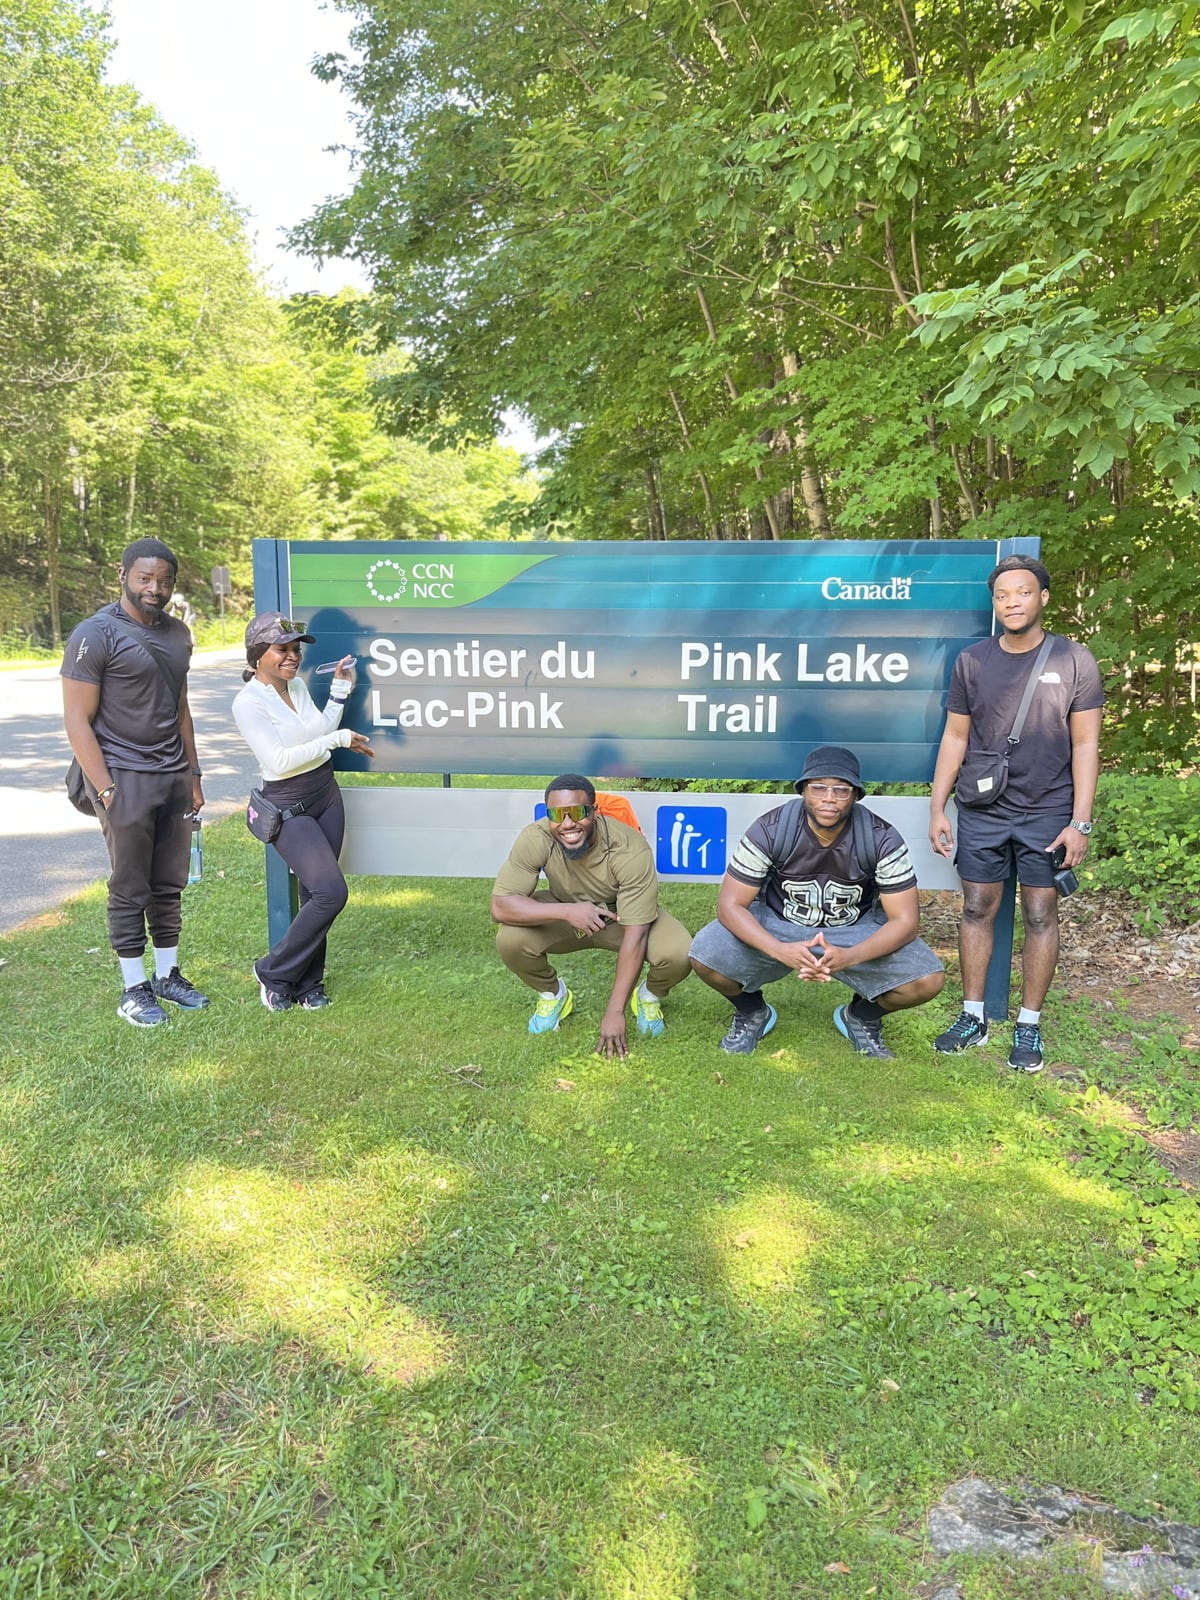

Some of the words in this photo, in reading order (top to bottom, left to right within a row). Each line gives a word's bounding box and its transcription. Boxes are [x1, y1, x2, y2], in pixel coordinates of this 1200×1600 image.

[412, 563, 454, 579] CCN
[821, 576, 912, 600] Canada
[413, 583, 454, 599] NCC
[369, 638, 526, 678] Sentier
[540, 641, 595, 679] du
[681, 642, 782, 681] Pink
[797, 643, 909, 682] Lake
[372, 690, 564, 729] Lac-Pink
[677, 694, 778, 733] Trail
